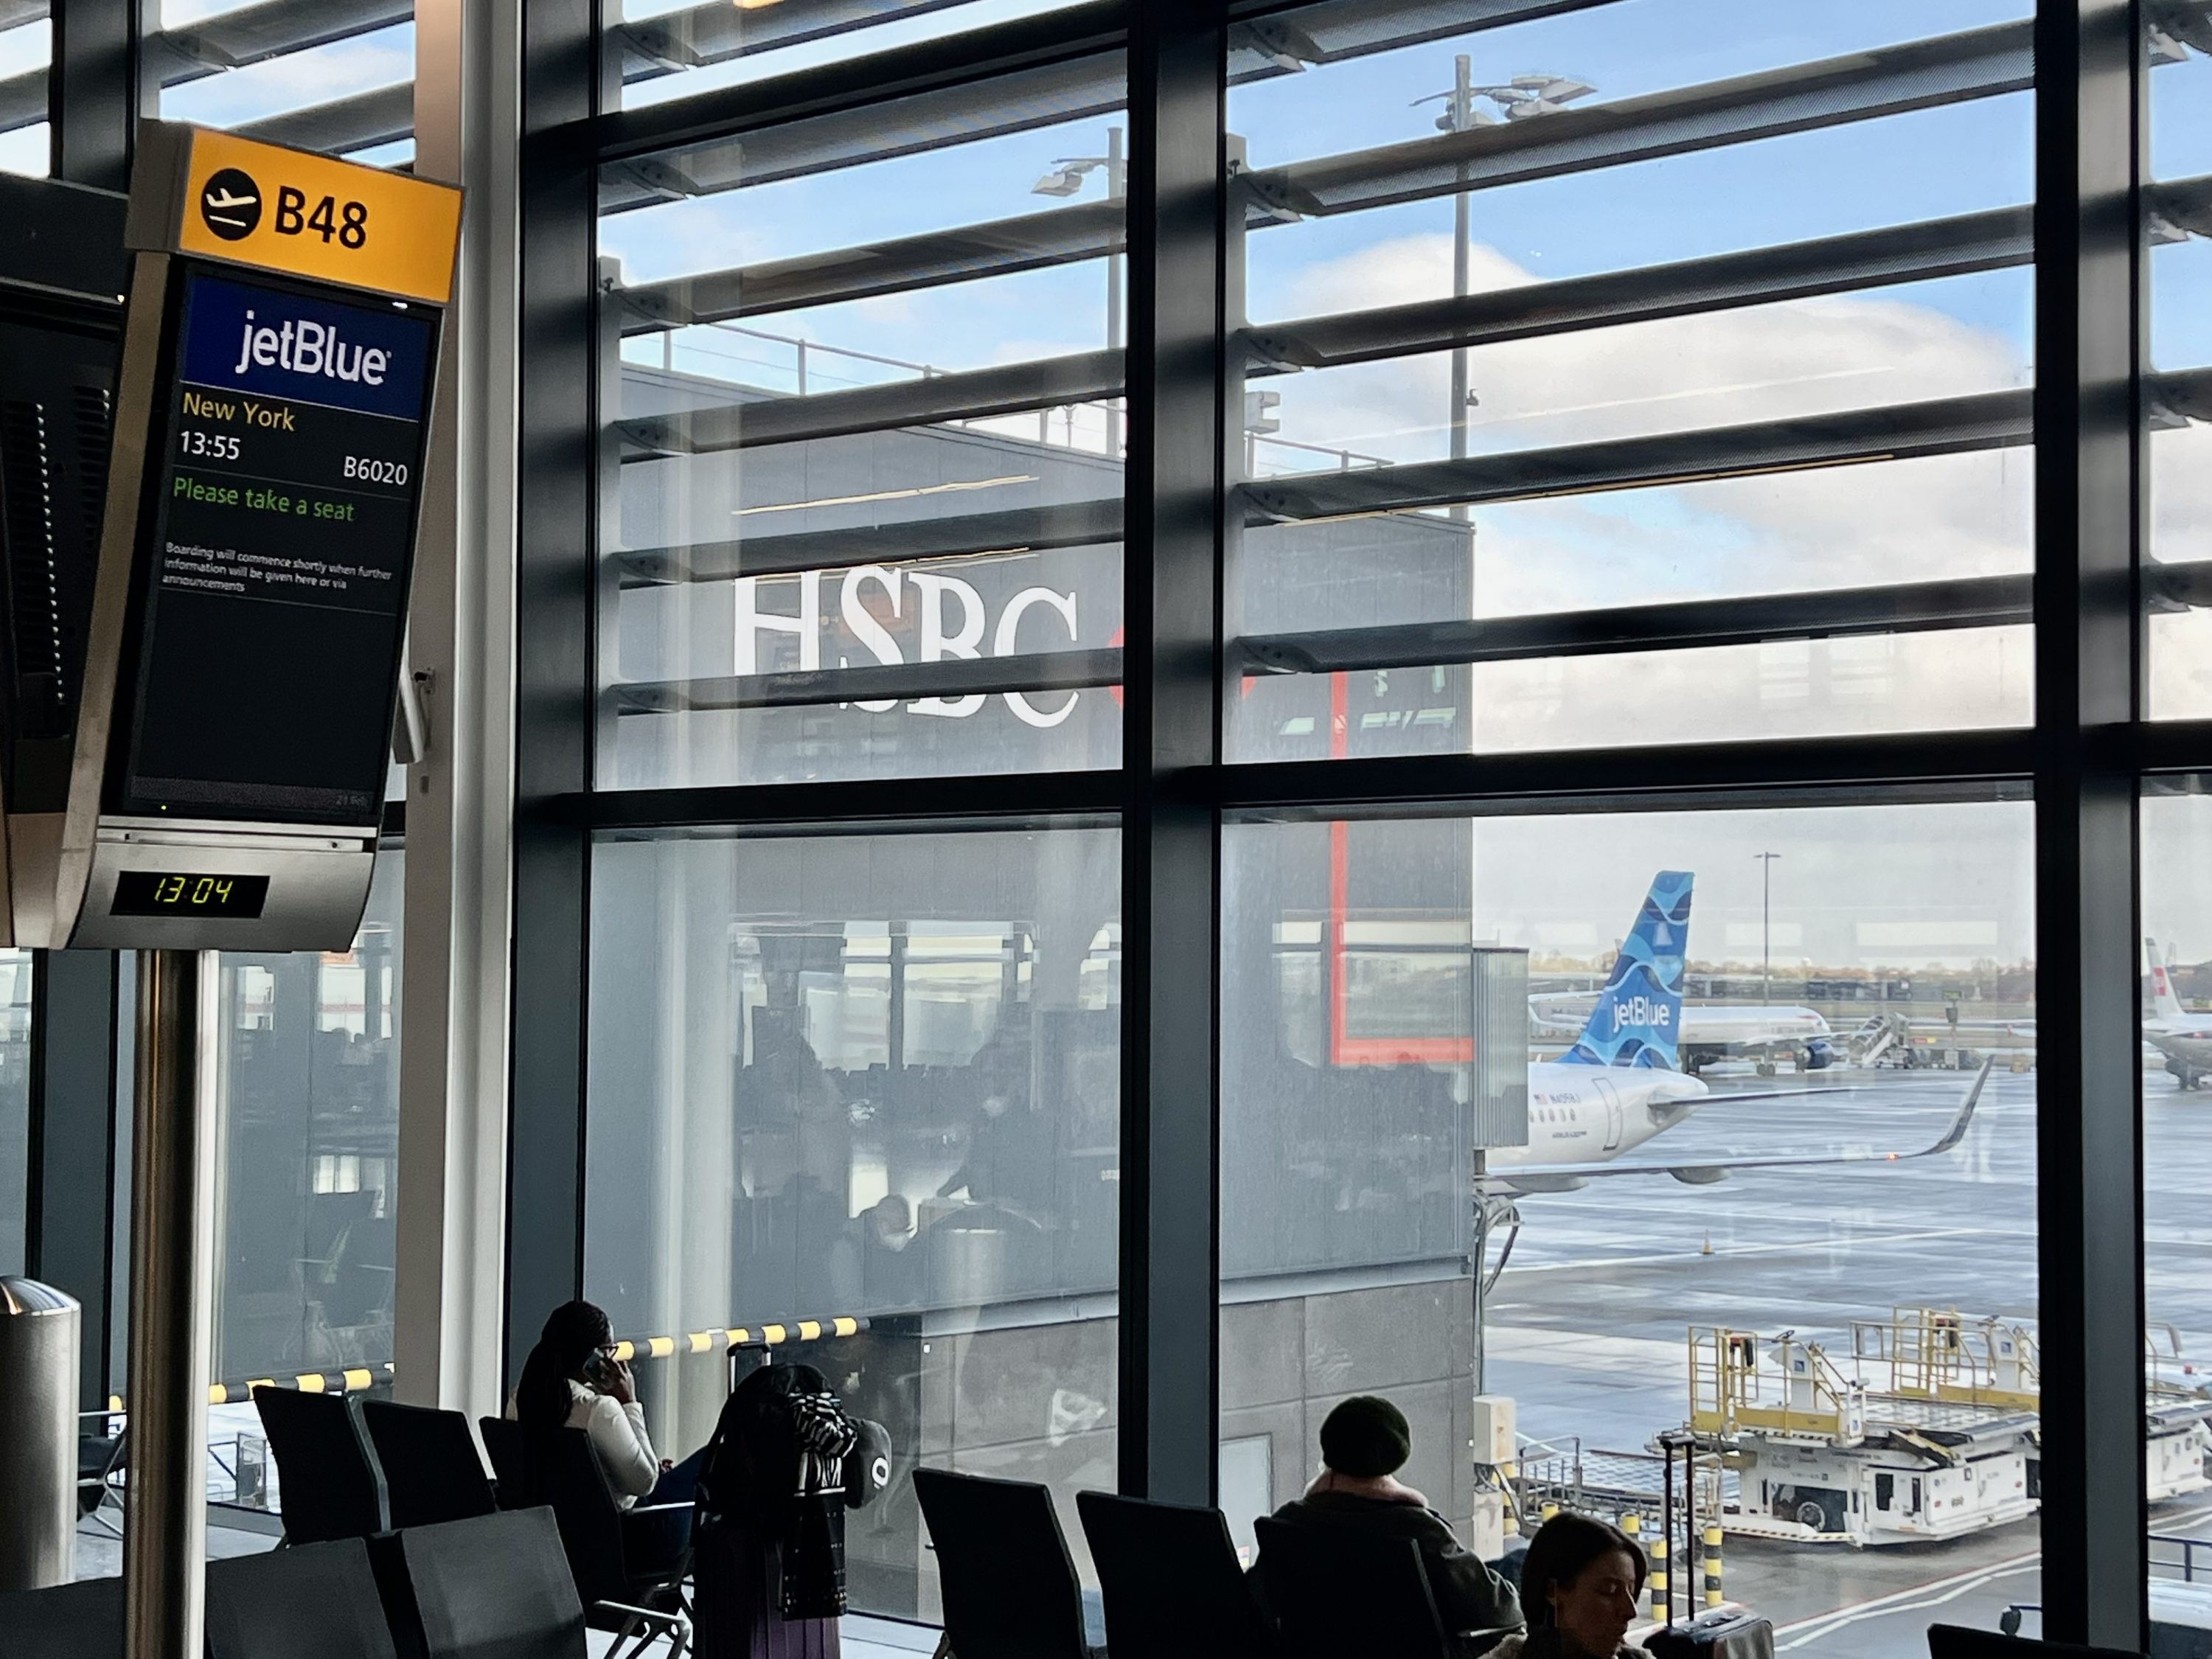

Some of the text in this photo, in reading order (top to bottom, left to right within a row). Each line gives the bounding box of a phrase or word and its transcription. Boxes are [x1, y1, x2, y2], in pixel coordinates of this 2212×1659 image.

[274, 185, 367, 249] B48
[235, 310, 387, 386] jetBlue
[183, 392, 295, 431] New York
[181, 431, 240, 459] 13:55
[344, 456, 408, 485] B6020
[173, 477, 355, 521] Please take a seat
[164, 557, 347, 588] information will be given here or via
[166, 542, 392, 580] Boarding will commence shortly when further
[162, 575, 245, 591] announcements
[734, 566, 1079, 728] HSBC
[1613, 995, 1670, 1033] jetBlue
